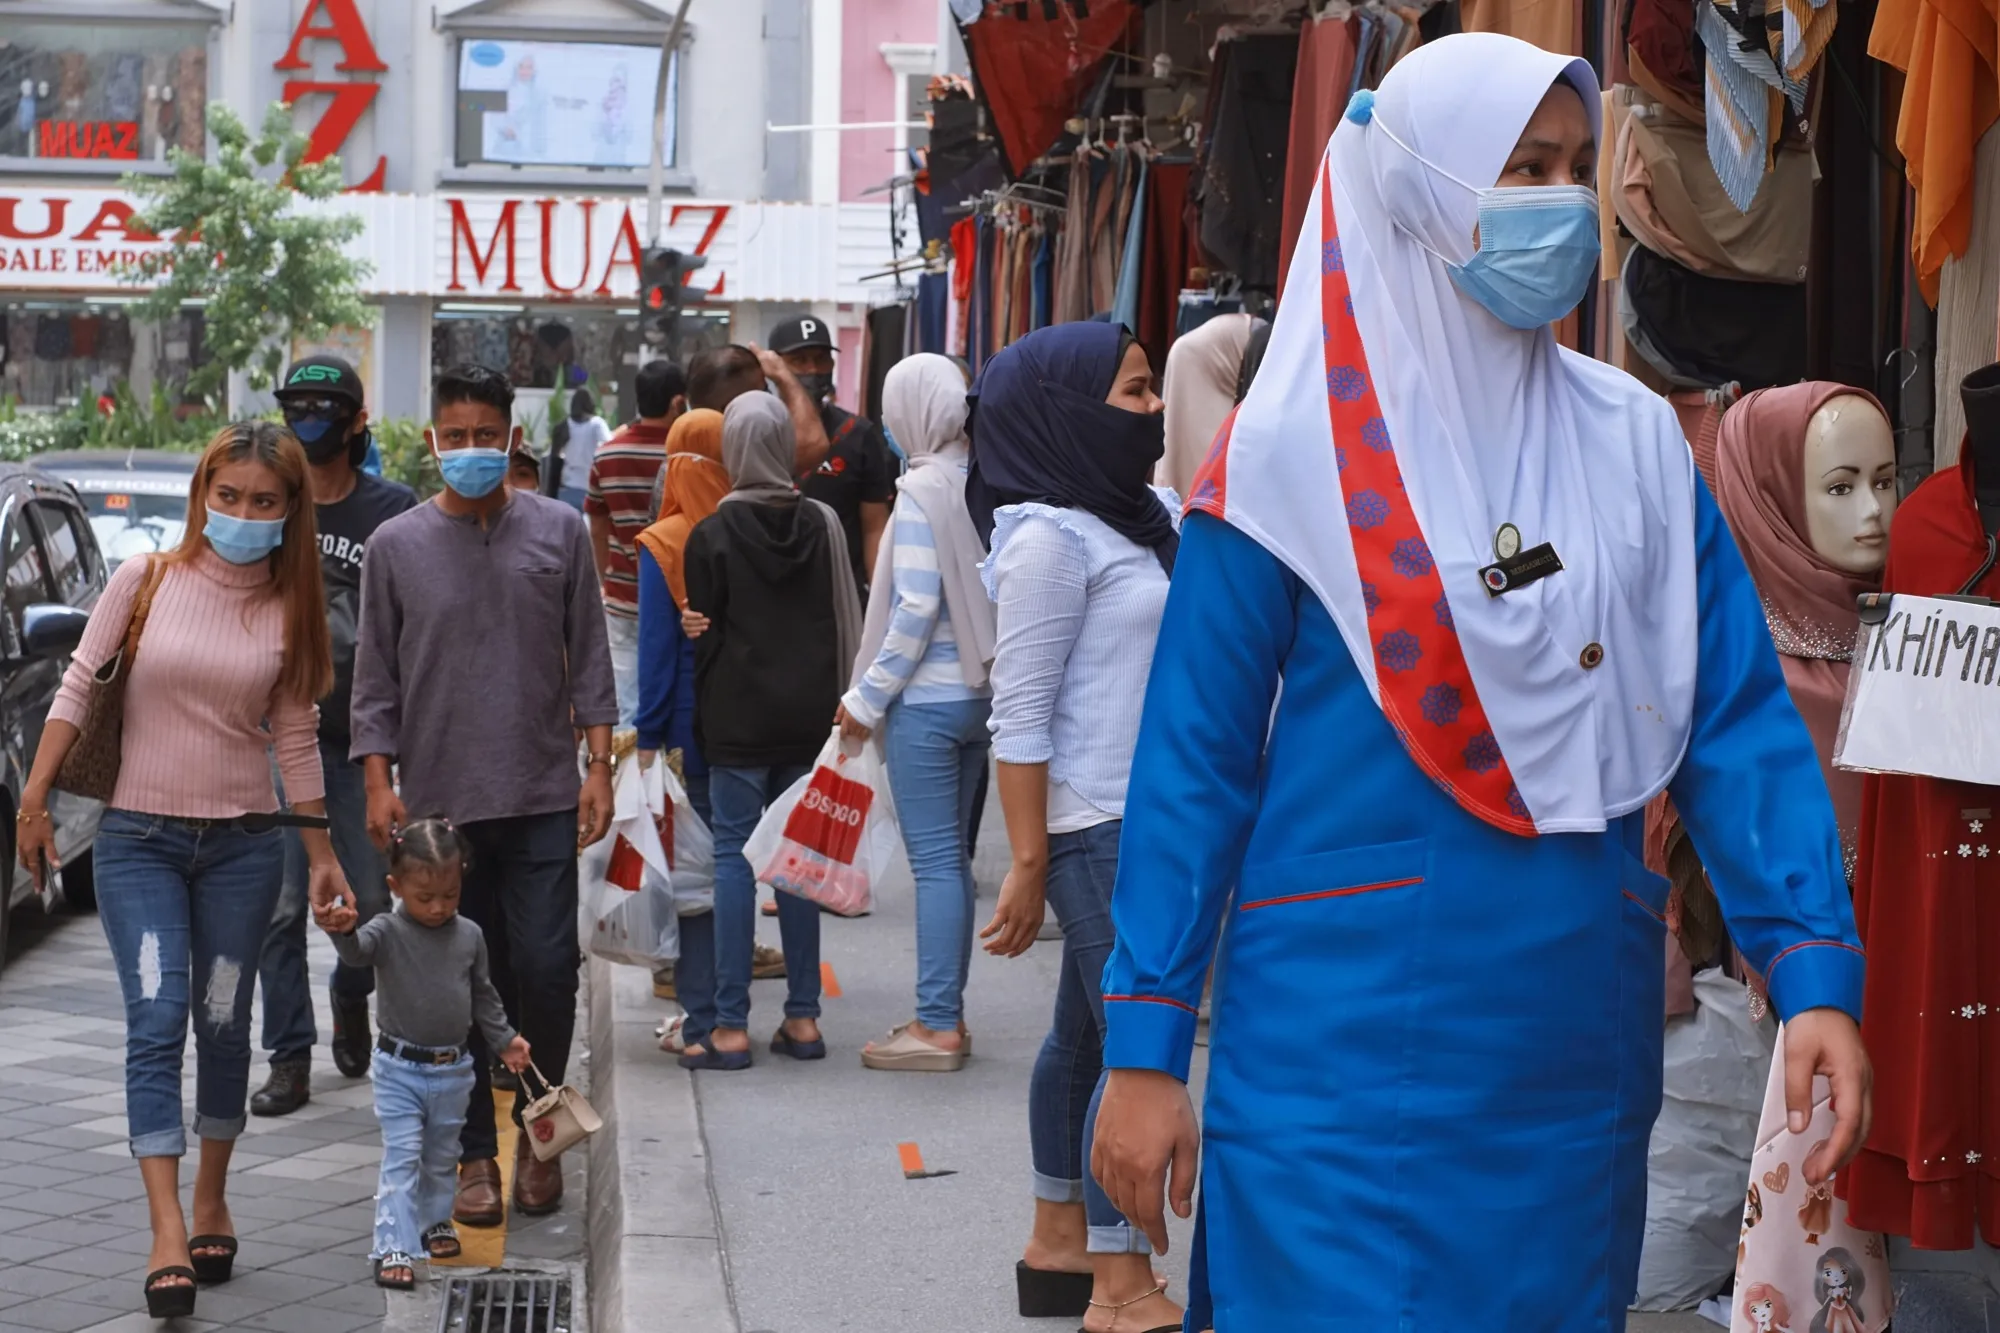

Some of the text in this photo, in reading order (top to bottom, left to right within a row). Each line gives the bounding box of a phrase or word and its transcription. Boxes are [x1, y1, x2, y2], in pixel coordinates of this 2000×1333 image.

[41, 120, 138, 161] MUAZ
[446, 199, 732, 296] MUAZ
[800, 320, 817, 340] P
